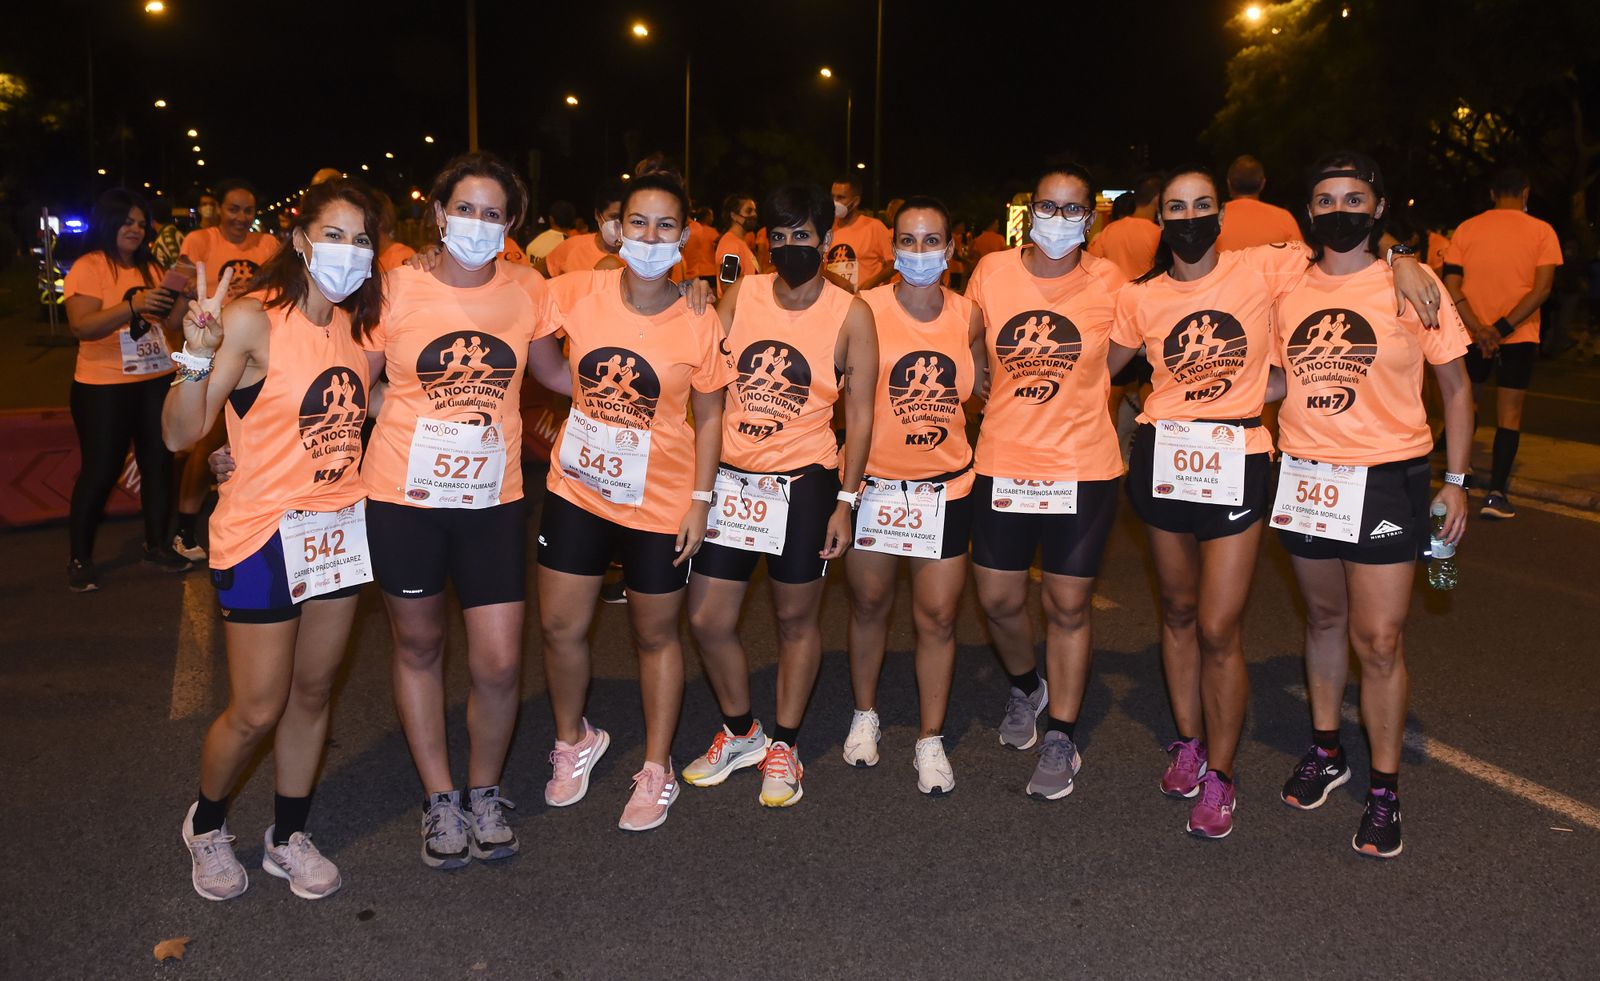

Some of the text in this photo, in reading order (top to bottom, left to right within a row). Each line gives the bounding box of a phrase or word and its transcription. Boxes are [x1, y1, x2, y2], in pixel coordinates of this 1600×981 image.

[137, 342, 160, 357] 538
[1004, 360, 1074, 373] LA NOCTURNA
[1012, 368, 1065, 380] del Guadalquivir
[1174, 373, 1188, 383] LA
[1187, 359, 1244, 376] NOCTURNA
[1293, 361, 1368, 377] LA NOCTURNA
[1301, 372, 1360, 386] del Guadalquivir
[427, 385, 505, 401] LA NOCTURNA
[434, 397, 497, 410] del Guadalquivir
[747, 392, 801, 416] NOCTURNA
[893, 403, 956, 417] LA NOCTURNA
[584, 399, 650, 429] LA NOCTURNA
[748, 402, 791, 421] Guadalquivir
[901, 415, 912, 425] del
[303, 438, 318, 451] LA
[311, 447, 324, 459] del
[433, 453, 489, 480] 527
[578, 446, 623, 478] 543
[1173, 449, 1222, 474] 604
[433, 481, 470, 489] CARRASCO
[470, 480, 497, 490] HUMANES
[996, 487, 1026, 495] ELISABETH
[1026, 489, 1053, 497] ESPINOSA
[1296, 480, 1339, 508] 549
[723, 495, 767, 522] 539
[1320, 511, 1351, 521] MORILLAS
[877, 505, 923, 530] 523
[884, 529, 909, 538] BARRERA
[304, 529, 346, 563] 542
[293, 567, 315, 579] CARMEN
